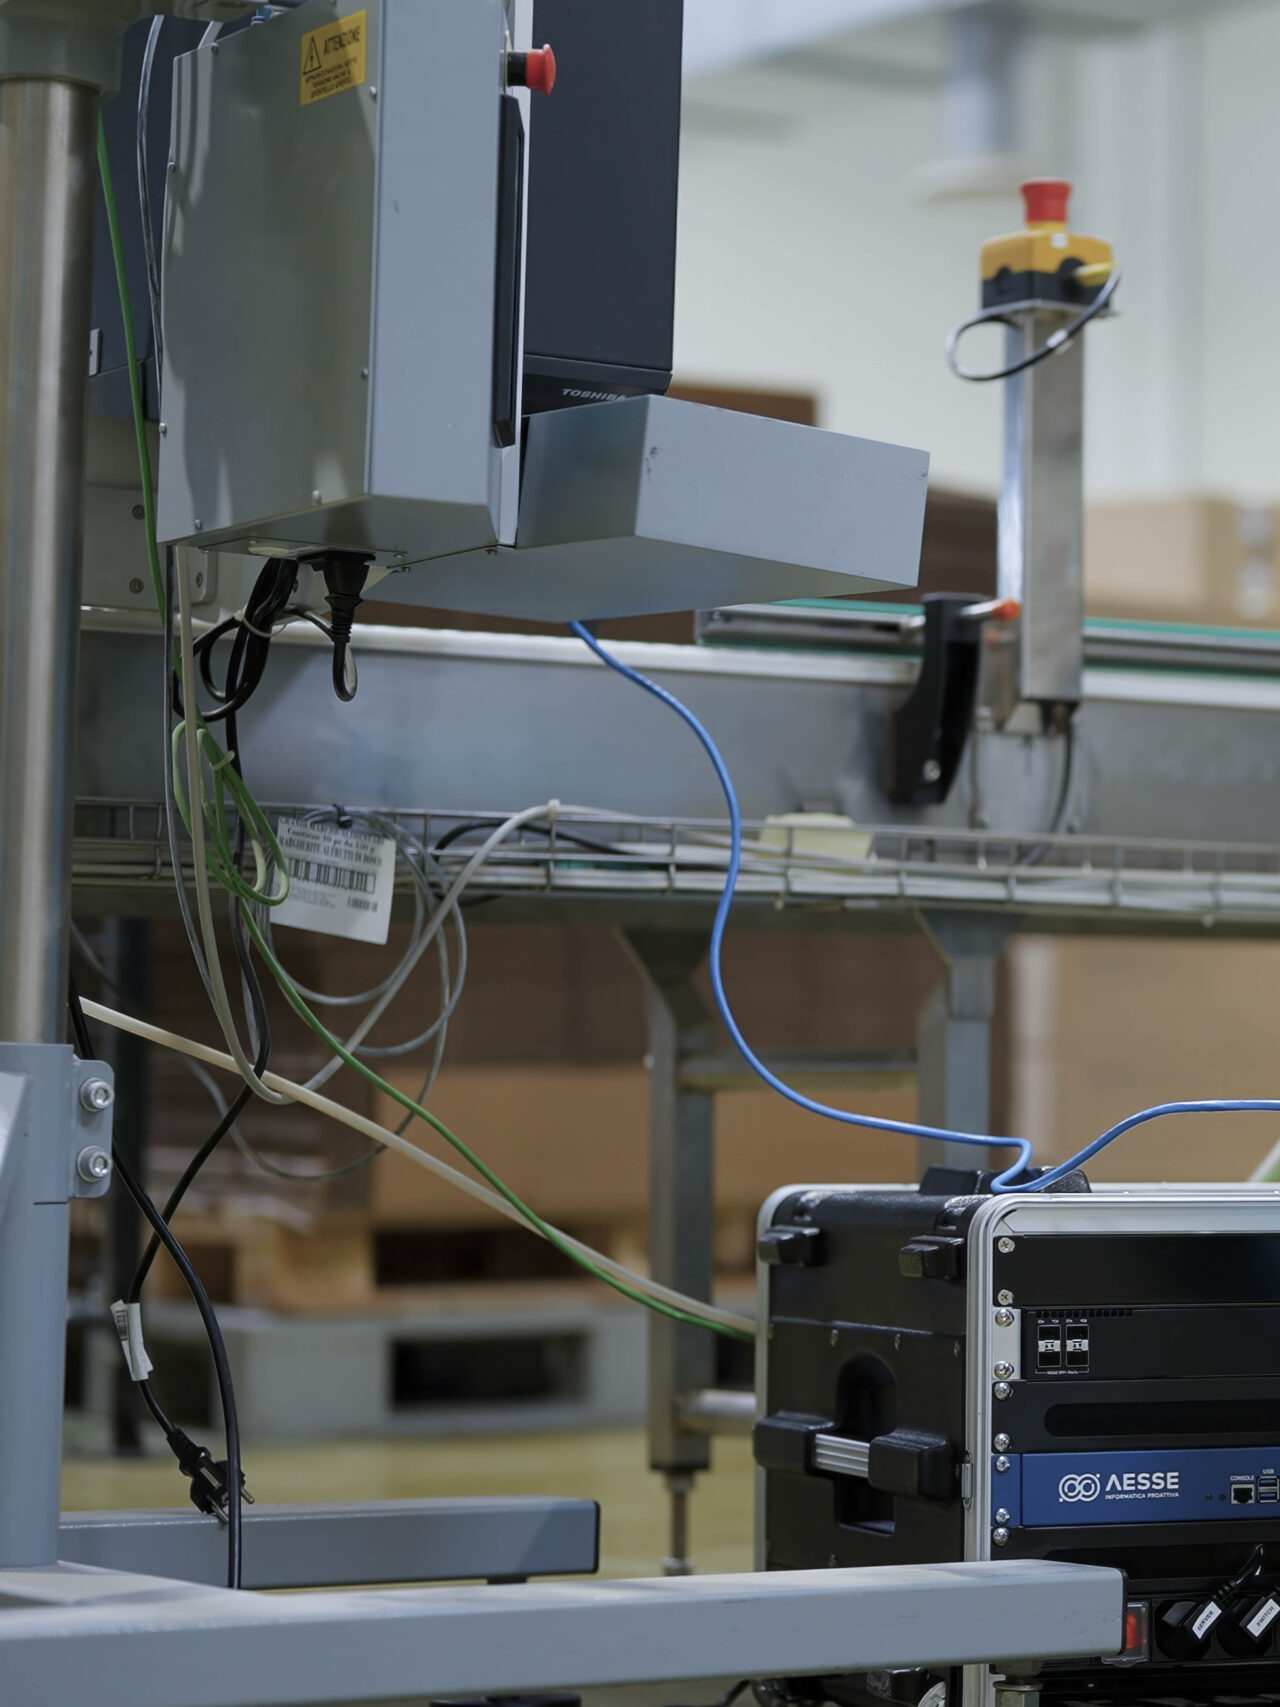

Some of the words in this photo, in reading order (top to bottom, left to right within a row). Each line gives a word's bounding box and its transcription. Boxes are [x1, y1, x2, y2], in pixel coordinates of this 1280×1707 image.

[323, 25, 360, 55] ATTENZIONE
[562, 388, 626, 401] TOSHIBA
[1105, 1472, 1179, 1491] AESSE
[1197, 1610, 1215, 1632] SERVER
[1256, 1605, 1275, 1628] SWITCH
